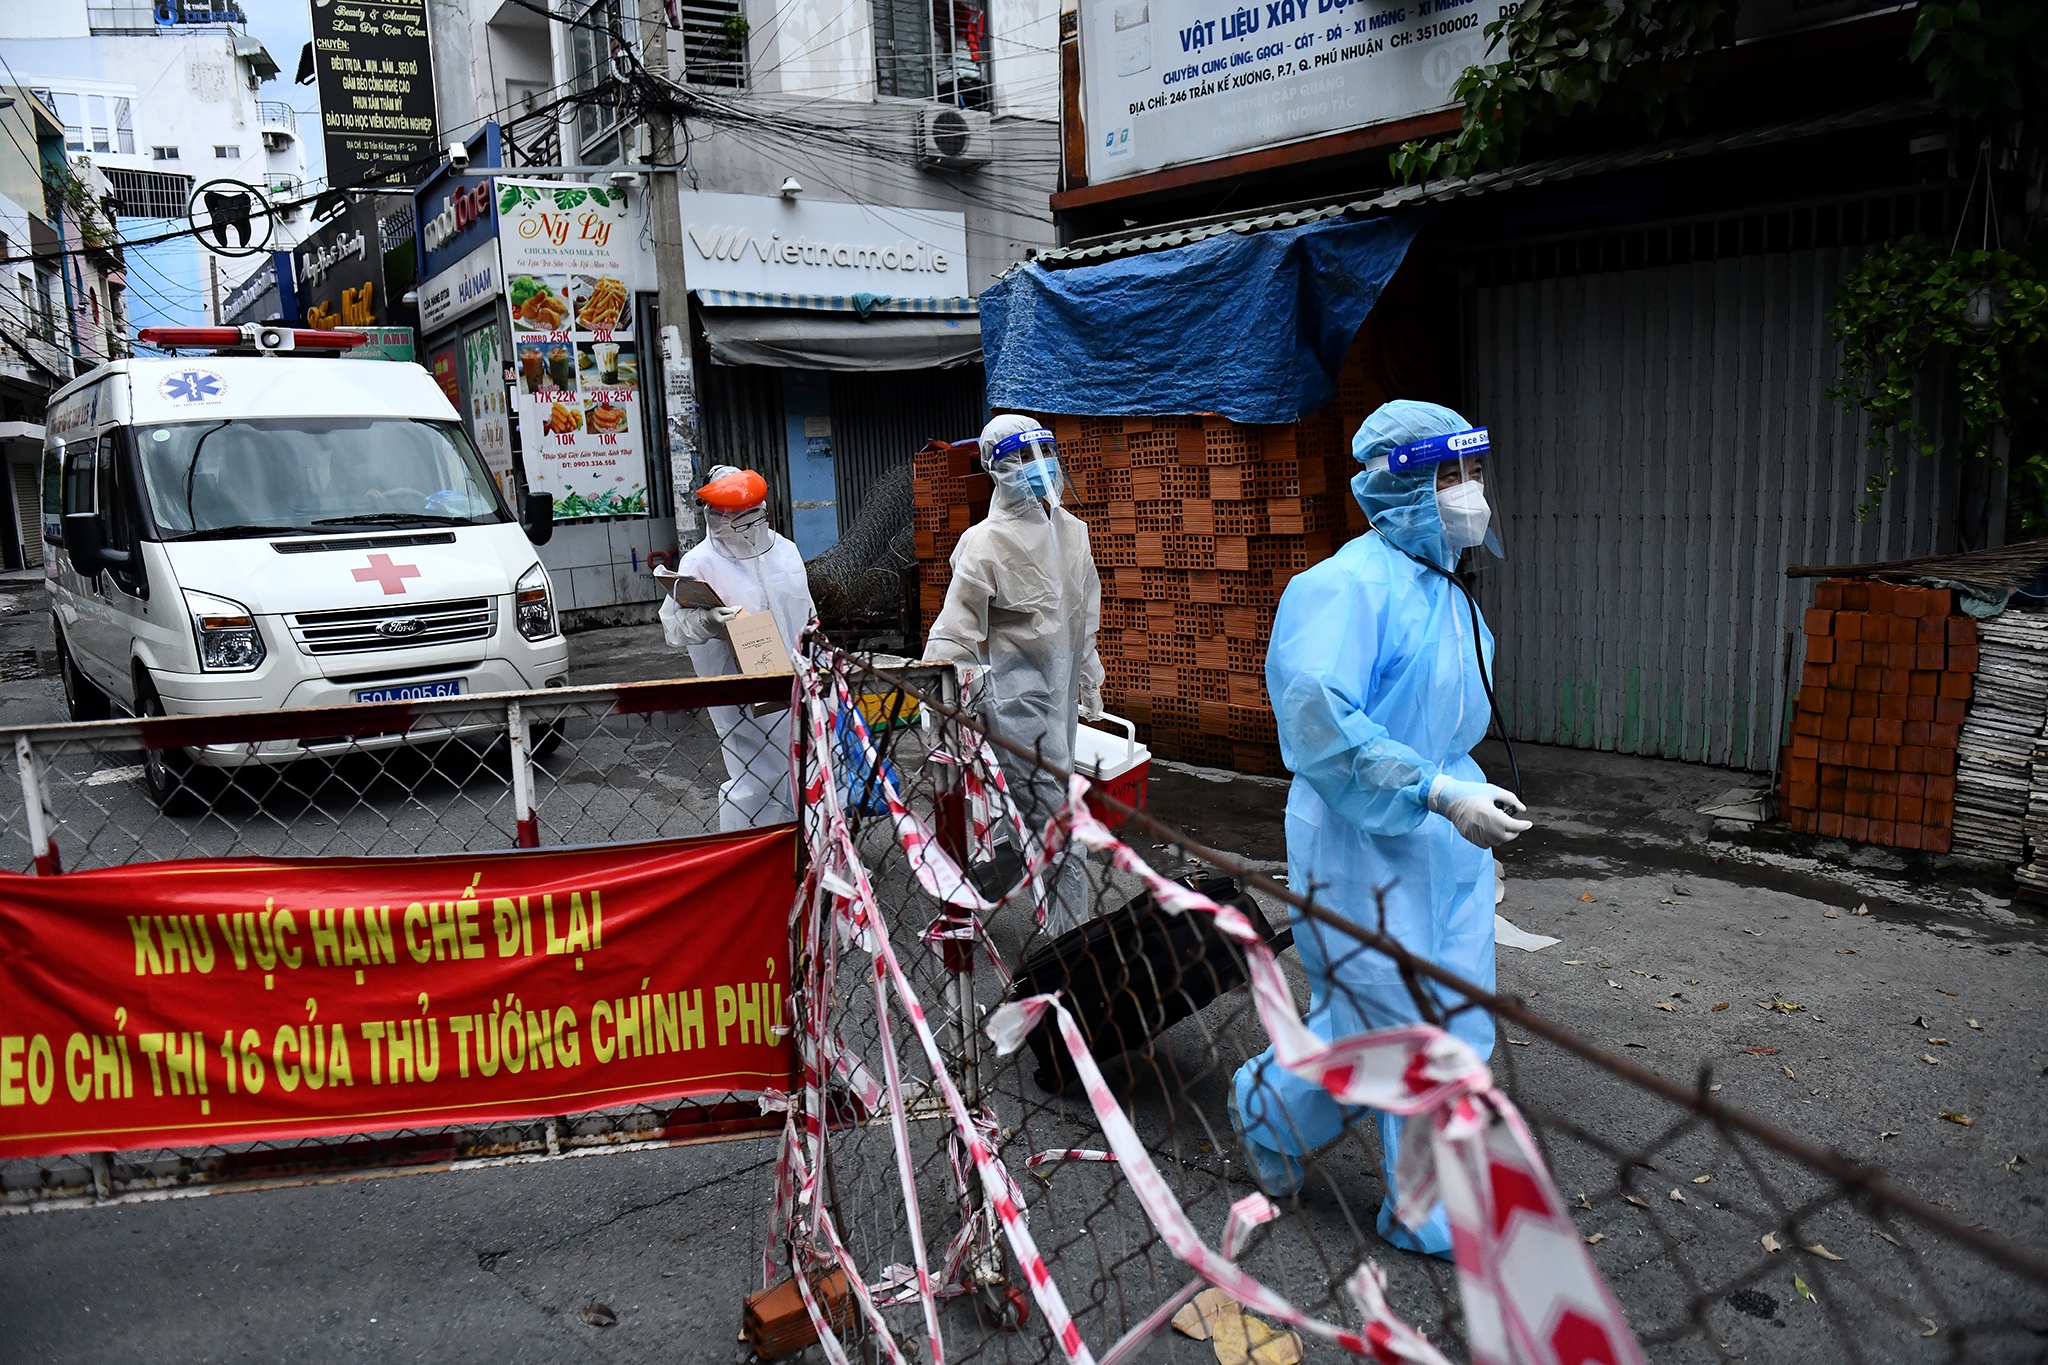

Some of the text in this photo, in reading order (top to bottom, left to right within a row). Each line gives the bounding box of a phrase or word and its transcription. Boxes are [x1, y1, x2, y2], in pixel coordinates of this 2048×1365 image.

[334, 5, 421, 26] Beauty & Academy
[1179, 20, 1215, 54] VẬT
[1221, 7, 1259, 42] LIỆU
[316, 37, 350, 49] CHUYÊN:
[1163, 64, 1199, 85] CHUYÊN
[1202, 57, 1227, 75] CUNG
[1256, 42, 1284, 62] GẠCH
[1295, 32, 1315, 50] CÁT
[1326, 23, 1342, 42] ĐÁ
[1354, 19, 1366, 34] XI
[1369, 8, 1405, 31] MĂNG
[1418, 0, 1431, 17] XI
[1129, 101, 1146, 116] ĐỊA
[1170, 90, 1187, 104] 246
[1218, 73, 1231, 92] KẾ
[1232, 68, 1274, 89] XƯƠNG,
[1277, 62, 1296, 77] P.7,
[1299, 59, 1311, 71] Q.
[1314, 47, 1338, 68] PHÚ
[1341, 38, 1383, 62] NHUẬN
[1390, 32, 1413, 48] CH:
[1416, 13, 1479, 42] 35100002
[399, 80, 411, 93] CAO
[326, 110, 341, 127] ĐÀO
[341, 114, 354, 129] TẠO
[354, 114, 369, 130] HỌC
[369, 112, 384, 129] VIÊN
[384, 114, 409, 130] CHUYÊN
[752, 230, 947, 273] vietnamobile
[459, 268, 492, 304] HẢI NAM
[383, 332, 410, 345] ANH
[521, 331, 570, 343] COMBO 25K
[593, 330, 613, 342] 20K
[532, 391, 576, 403] 17K-22K
[591, 391, 633, 403] 20K-25K
[555, 434, 576, 445] 10K
[598, 433, 617, 445] 10K
[1455, 437, 1478, 447] Face
[388, 620, 417, 633] Ford
[126, 872, 602, 990] KHU VỰC HẠN CHẾ ĐI LẠI
[0, 957, 782, 1116] EO CHỈ THỊ 16 CỦA THỦ TƯỚNG CHÍNH PHỦ
